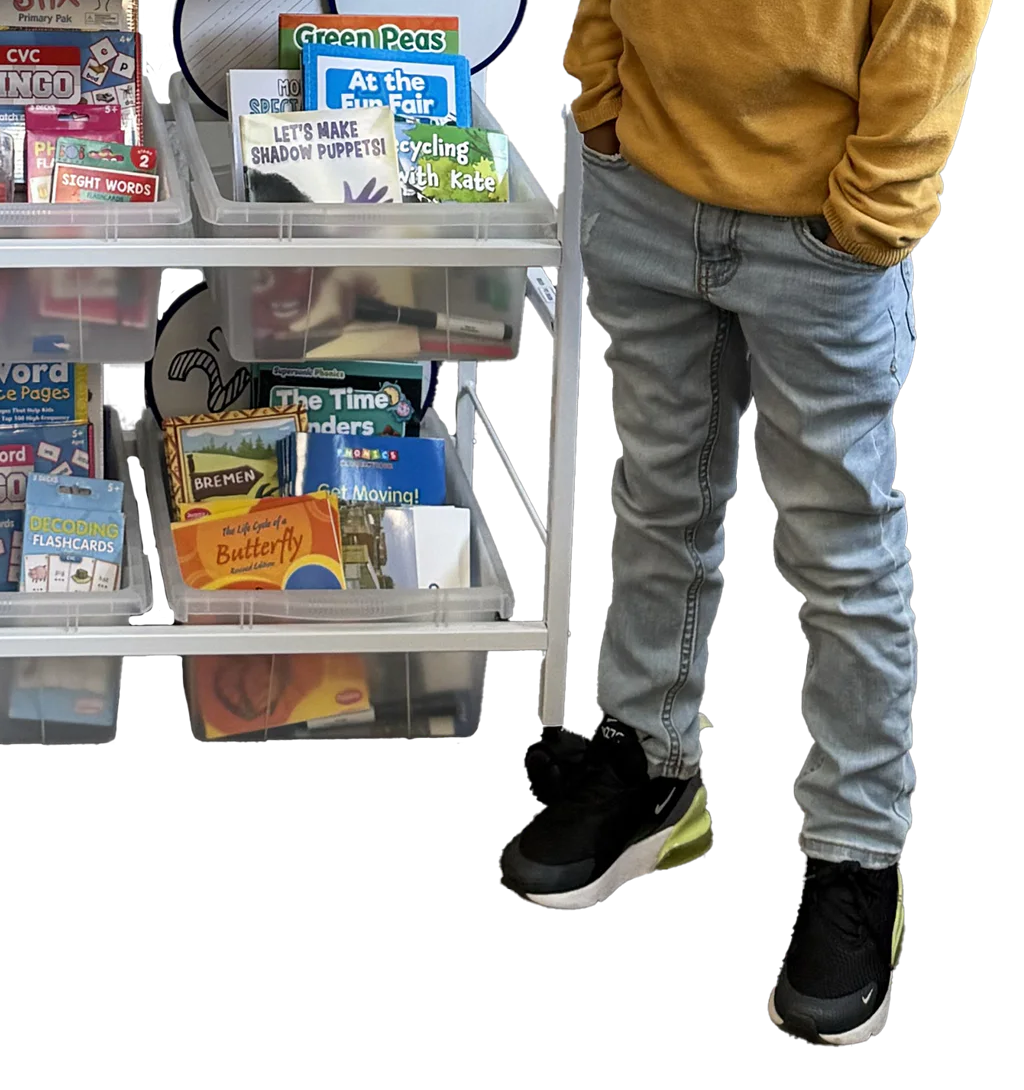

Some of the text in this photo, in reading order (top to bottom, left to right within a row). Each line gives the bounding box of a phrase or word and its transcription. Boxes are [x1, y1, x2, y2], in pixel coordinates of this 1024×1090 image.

[18, 13, 72, 24] Primary Pak
[295, 25, 445, 52] Green Peas
[6, 48, 40, 63] CVC
[348, 69, 425, 92] At the
[104, 105, 119, 114] 5+
[341, 93, 435, 115] Fun Fair
[274, 121, 359, 143] LET'S MAKE
[251, 138, 387, 165] SHADOW PUPPETS!
[139, 156, 150, 169] 2
[62, 173, 151, 196] SIGHT WORDS
[450, 169, 496, 192] Kate
[273, 366, 346, 379] Supersonic Phonics
[21, 387, 70, 401] Pages
[276, 387, 389, 410] The Time
[336, 448, 400, 462] PHONICS
[108, 484, 121, 492] 5+
[194, 470, 256, 491] BREMEN
[352, 485, 419, 504] Moving!
[29, 515, 119, 539] DECODING
[33, 534, 114, 553] FLASHCARDS
[216, 526, 304, 567] Butterfly
